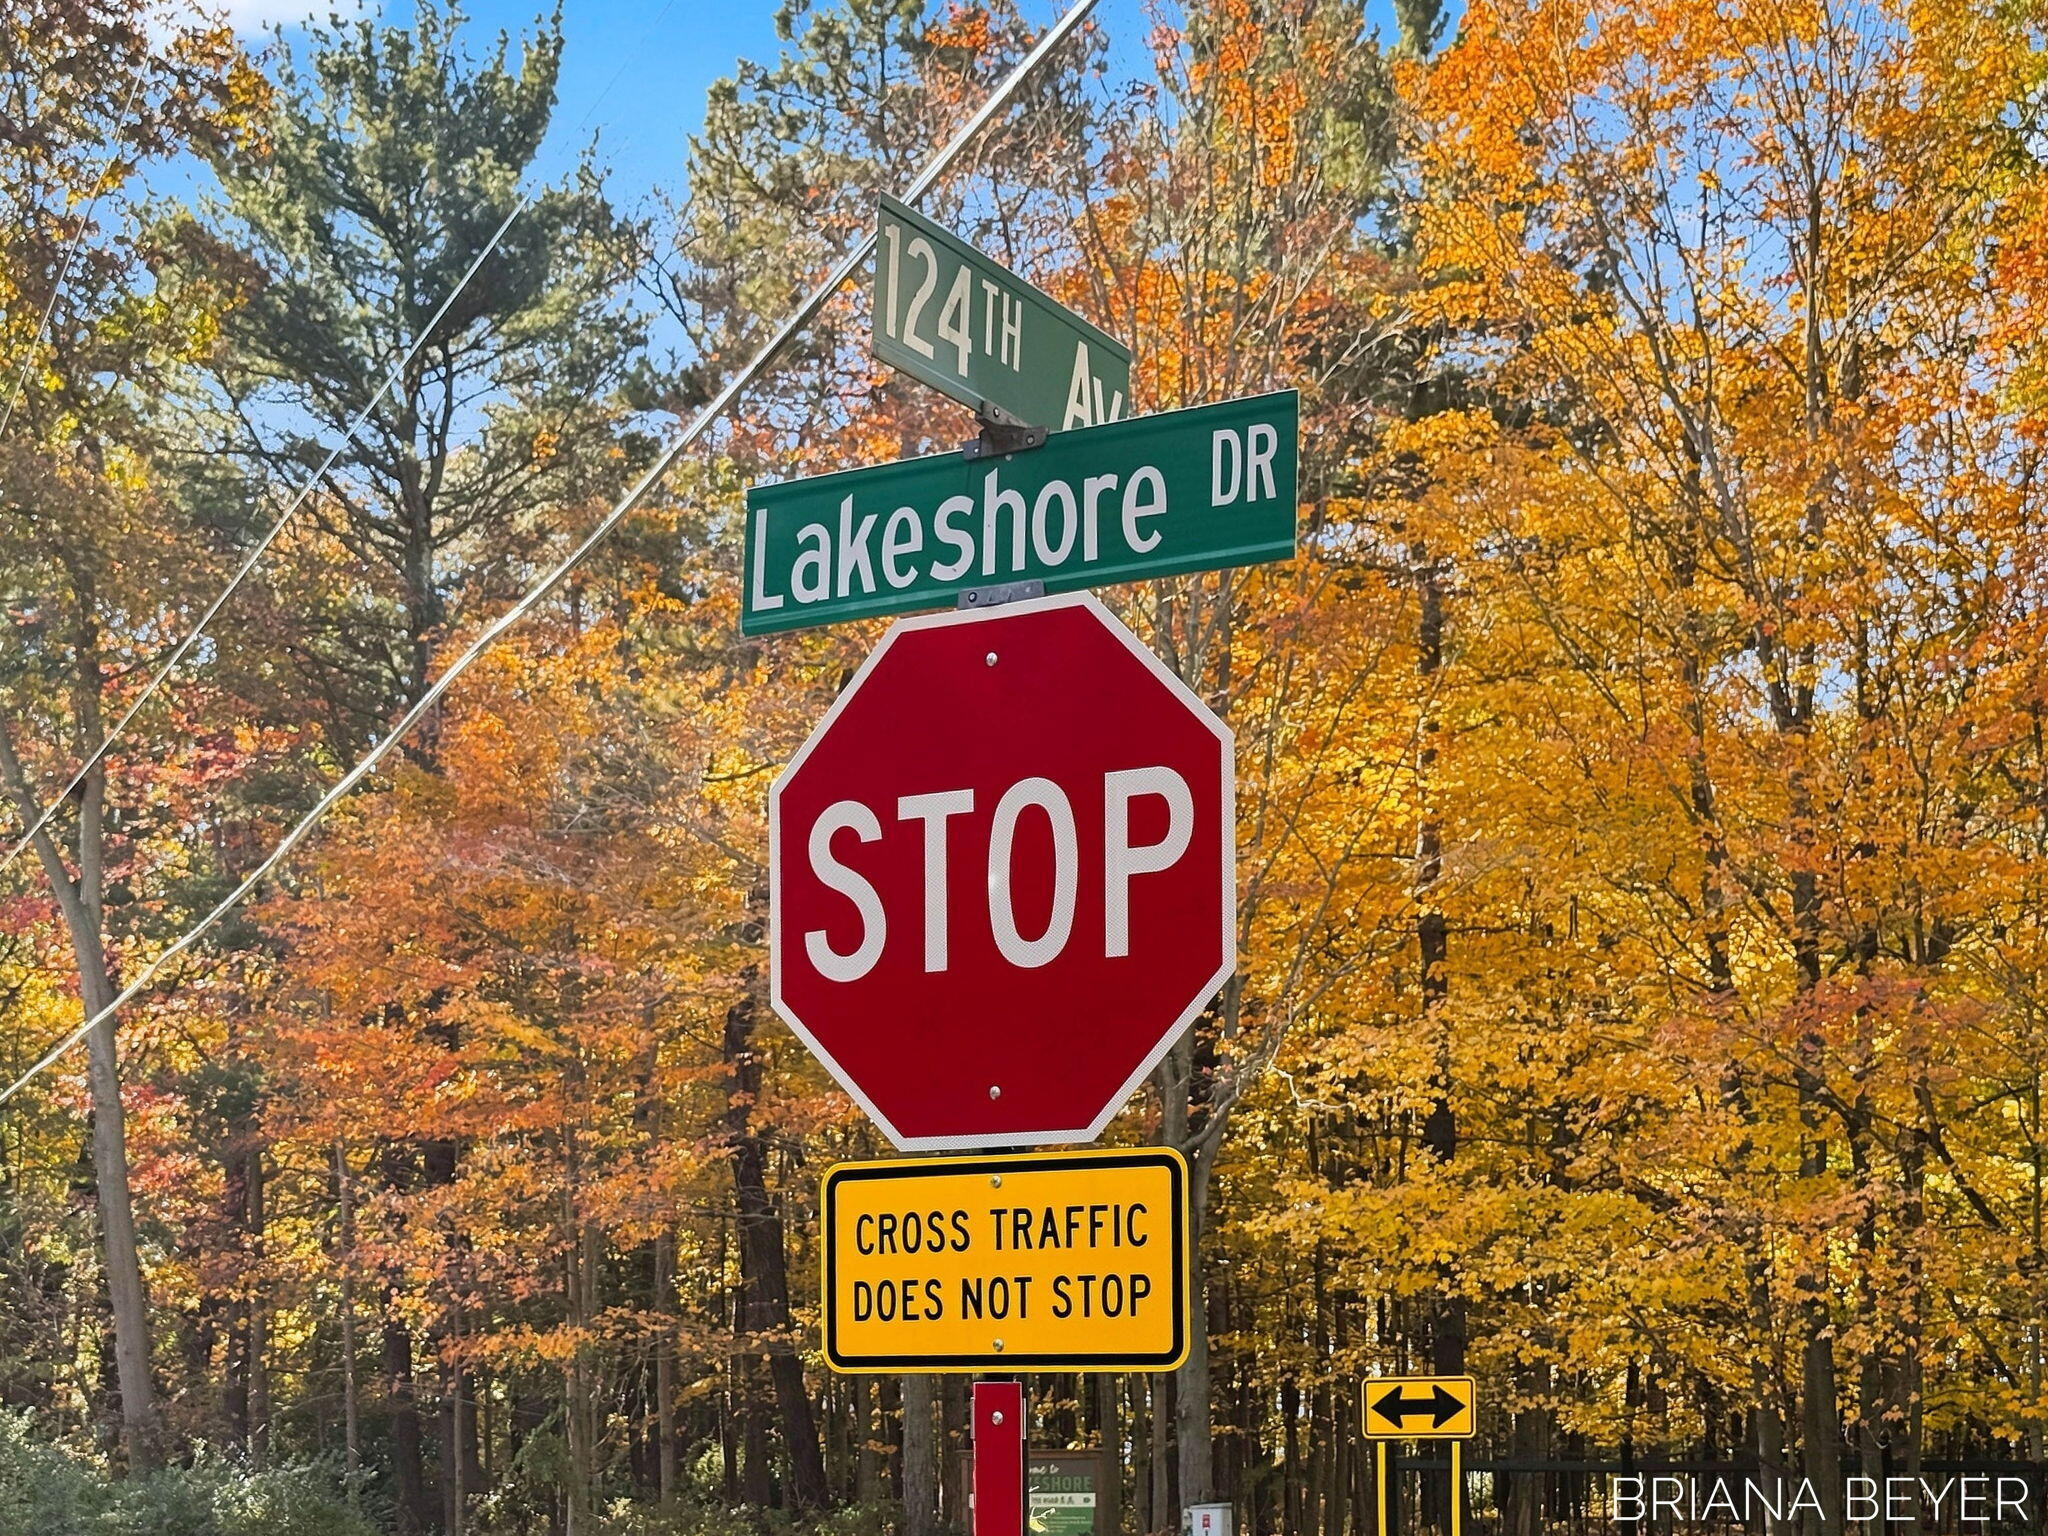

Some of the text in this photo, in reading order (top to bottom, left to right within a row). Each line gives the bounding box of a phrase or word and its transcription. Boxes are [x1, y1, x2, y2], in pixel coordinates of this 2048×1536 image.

[884, 223, 1022, 379] 124TH
[751, 423, 1278, 612] Lakeshore DR
[804, 765, 1194, 983] STOP
[854, 1274, 1151, 1321] DOES NOT STOP
[856, 1203, 1148, 1255] CROSS TRAFFIC
